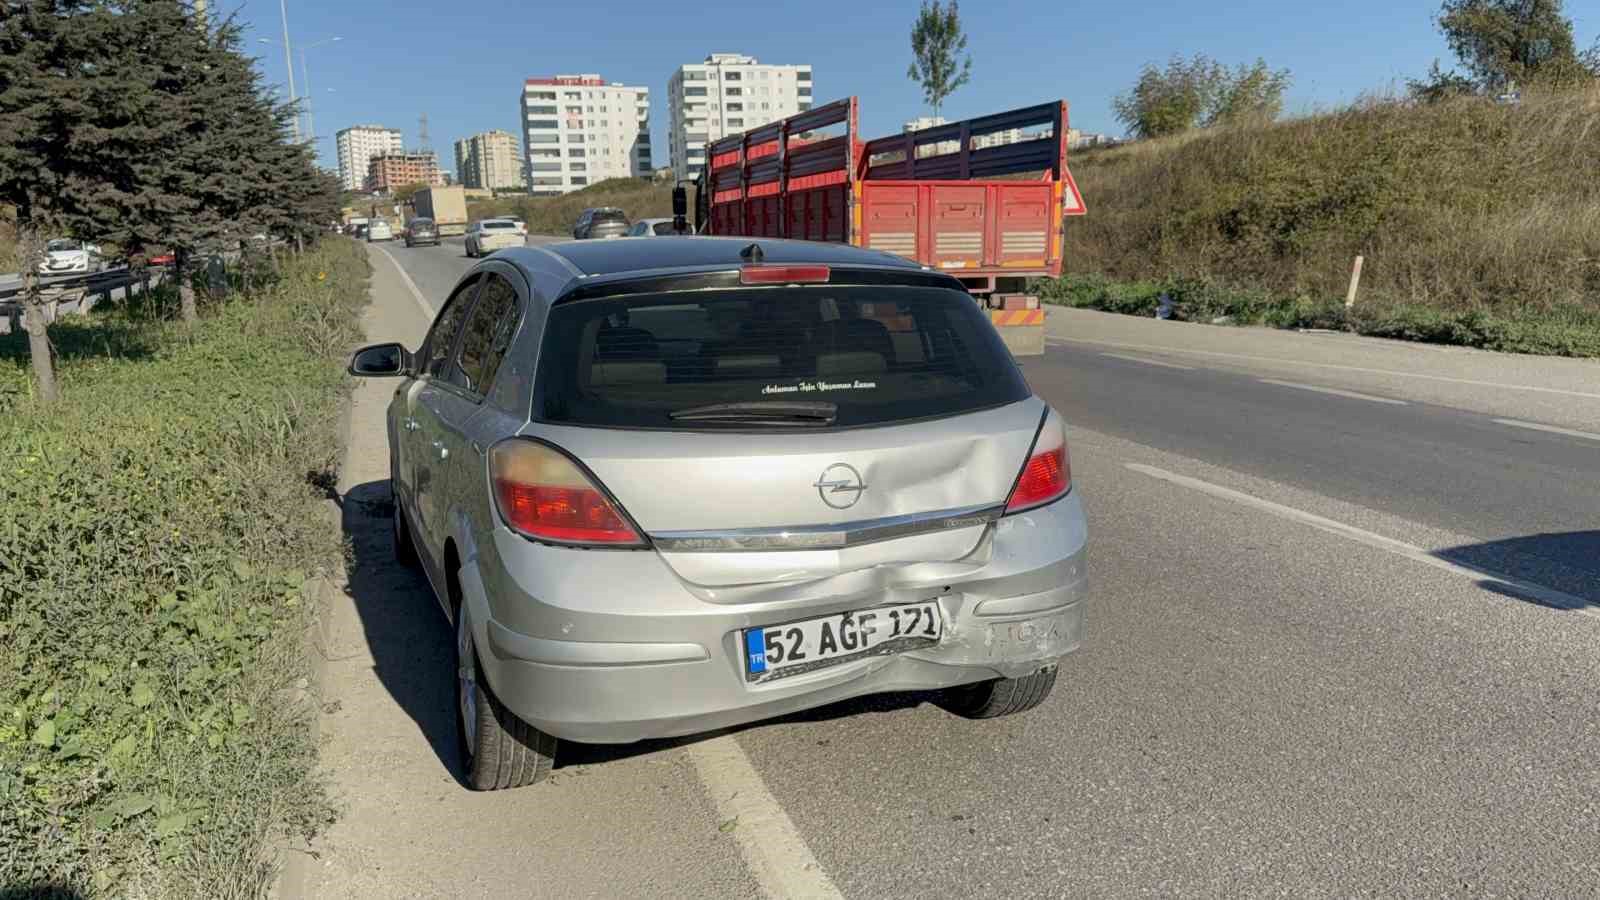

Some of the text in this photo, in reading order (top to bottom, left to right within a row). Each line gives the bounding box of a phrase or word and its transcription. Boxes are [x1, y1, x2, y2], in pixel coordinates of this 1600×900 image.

[765, 628, 806, 664] 52
[888, 606, 936, 637] 171
[751, 653, 763, 664] TR
